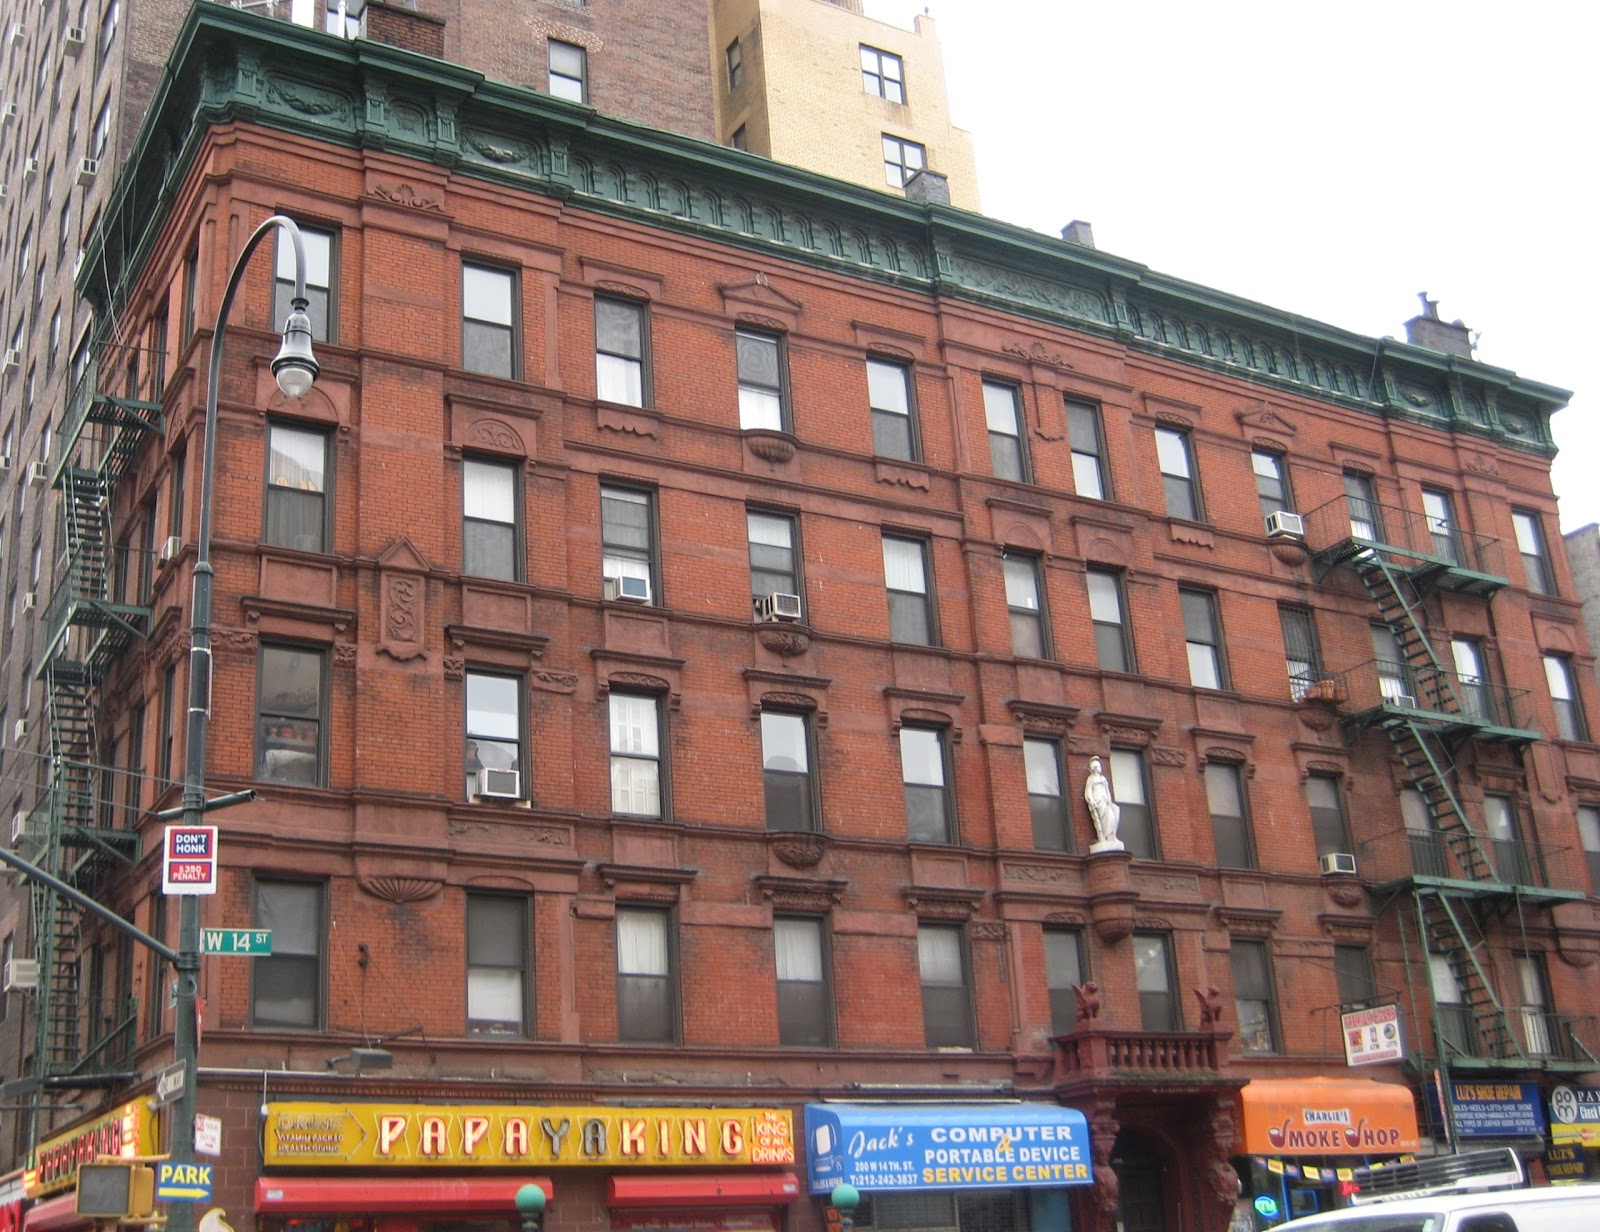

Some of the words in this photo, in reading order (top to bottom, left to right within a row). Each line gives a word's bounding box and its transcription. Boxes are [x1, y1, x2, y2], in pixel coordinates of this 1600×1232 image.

[176, 834, 207, 843] DON'T
[176, 844, 206, 853] HONK
[173, 872, 206, 880] PENALTY
[179, 865, 202, 873] $350
[207, 932, 223, 951] W
[232, 932, 251, 951] 14
[256, 933, 268, 944] ST
[1496, 1085, 1523, 1100] REPAIR
[278, 1113, 344, 1130] DRINK
[1304, 1109, 1349, 1123] CHARLIE'S
[275, 1129, 311, 1143] VITAMIN
[312, 1135, 343, 1143] PACKED
[621, 1117, 744, 1156] KING
[756, 1121, 788, 1137] KING
[931, 1125, 1072, 1143] COMPUTER
[847, 1126, 914, 1159] Jack's
[996, 1133, 1012, 1153] &
[752, 1147, 795, 1162] DRINKS
[924, 1148, 1015, 1164] PORTABLE
[1019, 1146, 1080, 1162] DEVICE
[854, 1161, 868, 1172] 200
[869, 1161, 877, 1171] W
[903, 1160, 915, 1171] ST.
[922, 1166, 1008, 1183] SERVICE
[1012, 1163, 1088, 1181] CENTER
[160, 1164, 211, 1185] PARK
